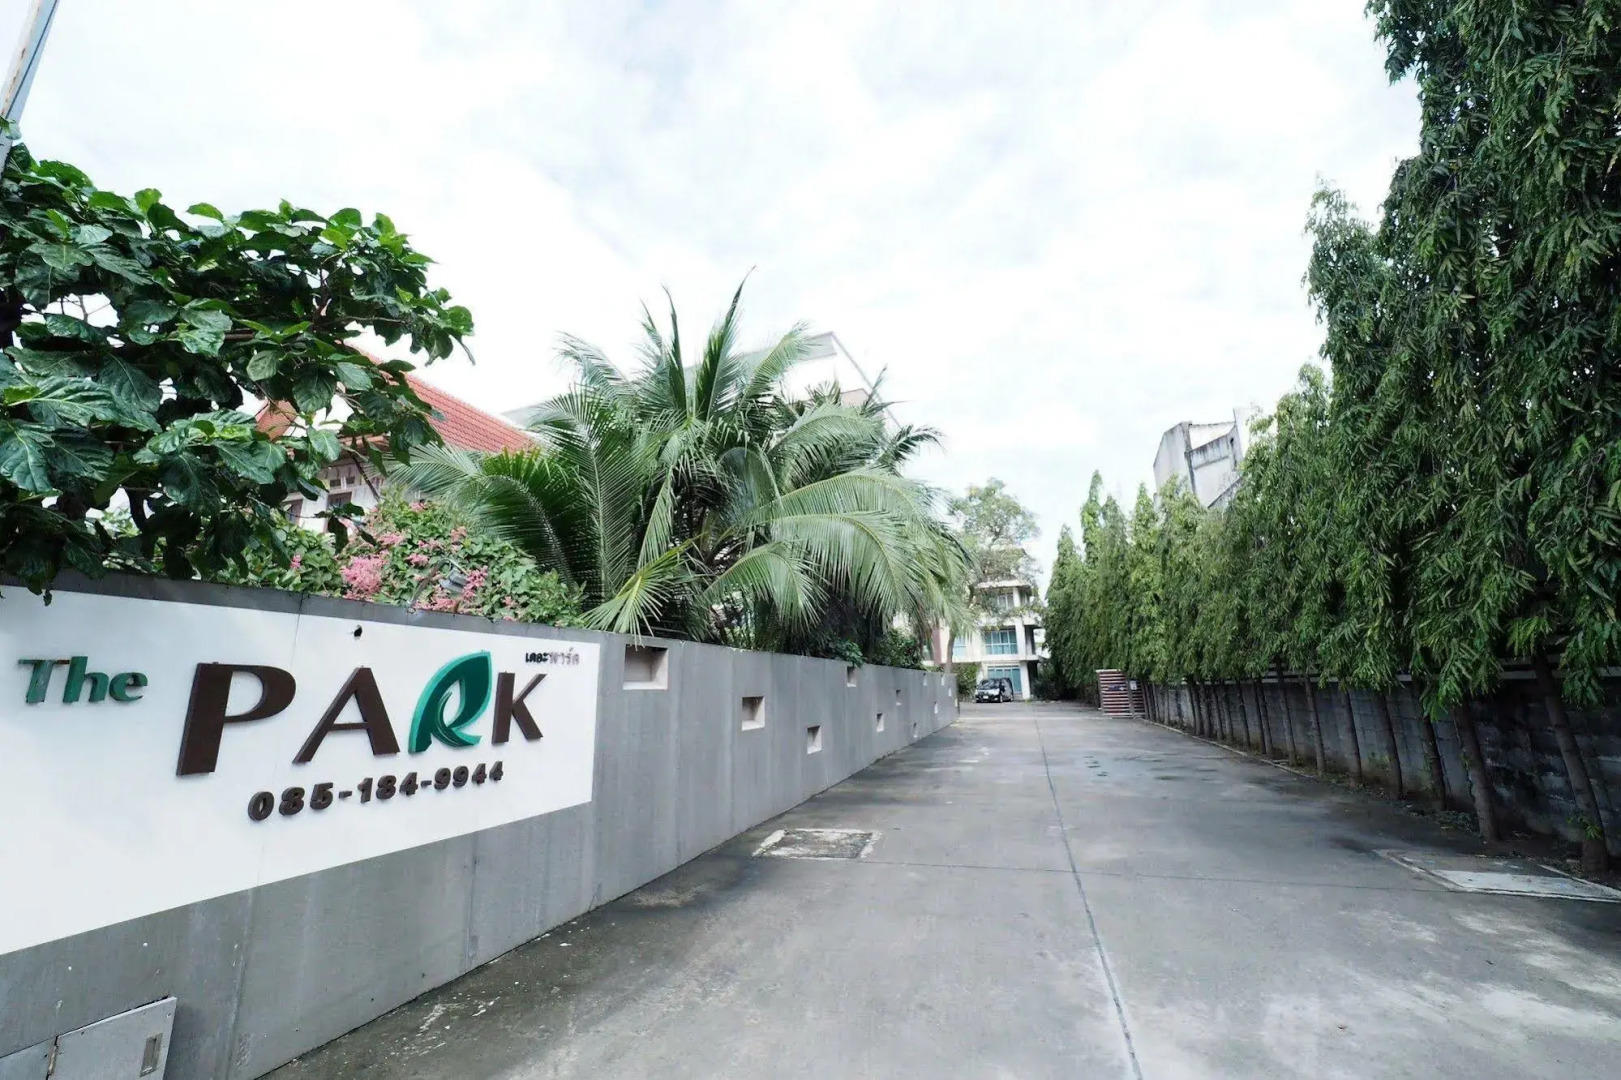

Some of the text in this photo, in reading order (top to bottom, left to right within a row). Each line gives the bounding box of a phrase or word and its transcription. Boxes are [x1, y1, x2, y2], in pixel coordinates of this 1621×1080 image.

[18, 651, 548, 776] The PARK
[248, 761, 504, 821] 085-184-9944
